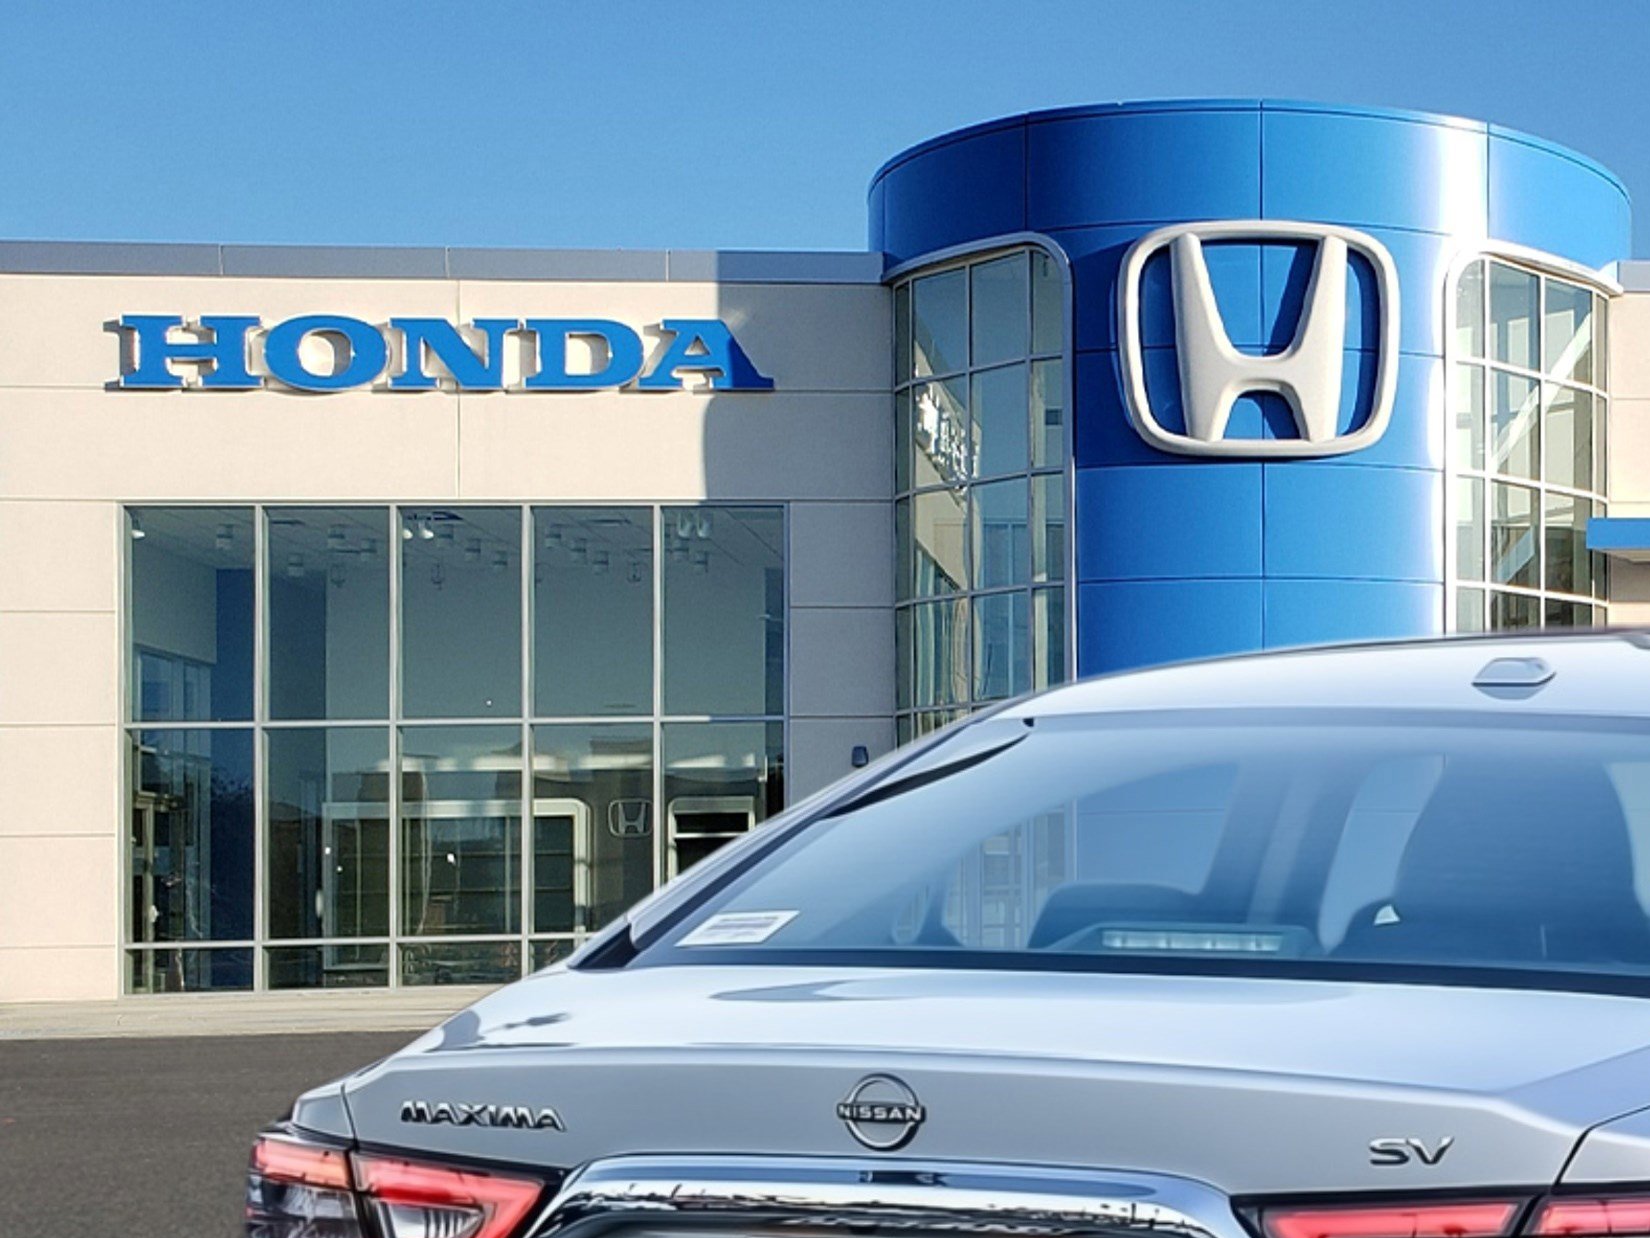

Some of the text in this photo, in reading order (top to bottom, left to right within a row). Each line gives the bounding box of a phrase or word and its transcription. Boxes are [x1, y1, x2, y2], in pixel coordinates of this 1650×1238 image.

[112, 313, 775, 392] HONDA
[400, 1100, 568, 1132] MAXIMA
[839, 1104, 922, 1121] NISSAN
[1369, 1136, 1455, 1166] SV
